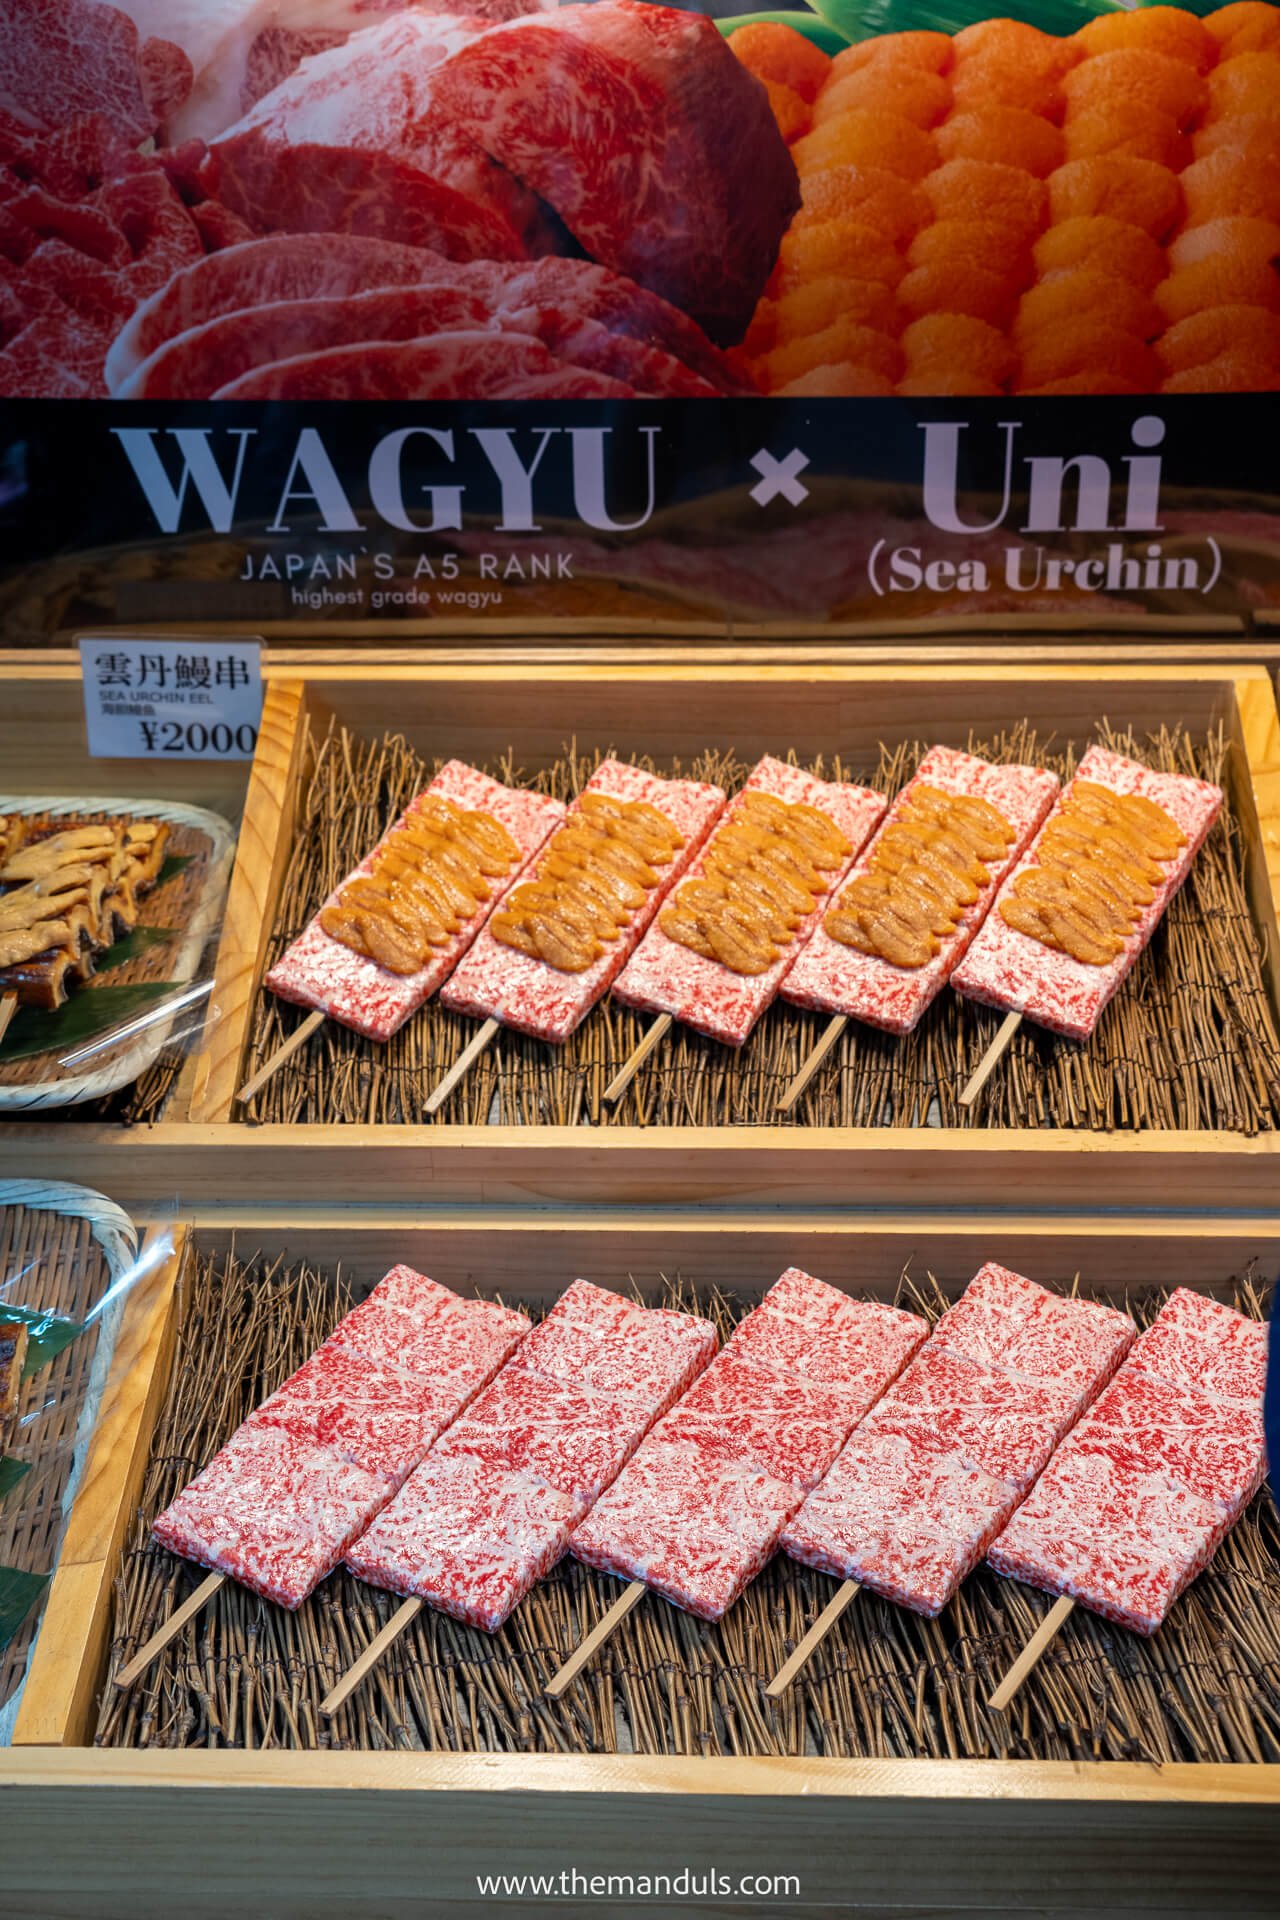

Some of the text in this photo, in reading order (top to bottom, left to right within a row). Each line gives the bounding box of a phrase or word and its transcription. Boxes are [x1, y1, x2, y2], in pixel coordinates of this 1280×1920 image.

[109, 427, 662, 533] WAGYU
[916, 415, 1166, 535] Uni
[413, 553, 460, 579] A5
[480, 553, 574, 579] RANK
[868, 535, 1222, 597] (Sea Urchin)
[291, 586, 503, 609] highest grade wagyu
[95, 652, 250, 690] 雲丹鰻串
[99, 690, 215, 705] SEA URCHIN EEL
